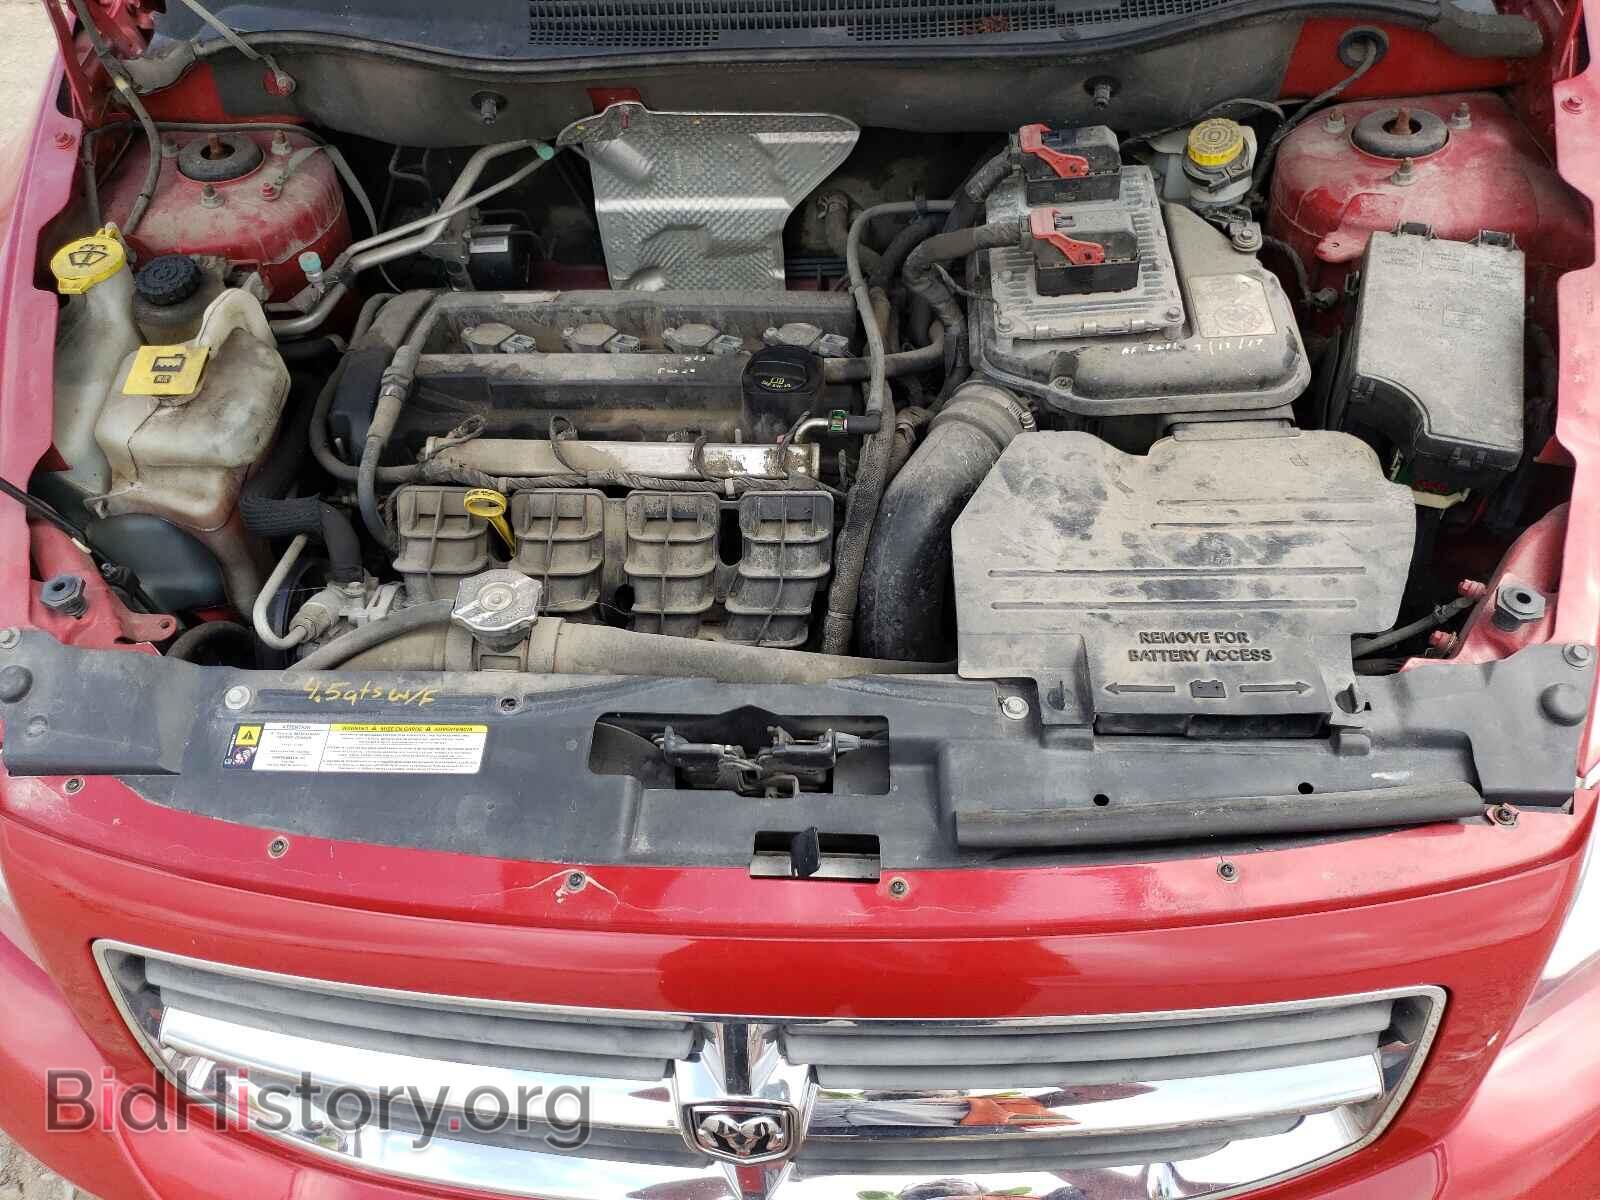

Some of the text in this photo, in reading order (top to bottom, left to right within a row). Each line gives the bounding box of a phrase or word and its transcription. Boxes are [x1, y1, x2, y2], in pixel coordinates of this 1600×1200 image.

[1139, 631, 1250, 644] REMOVE FOR
[1128, 649, 1273, 662] BATTERY ACCESS
